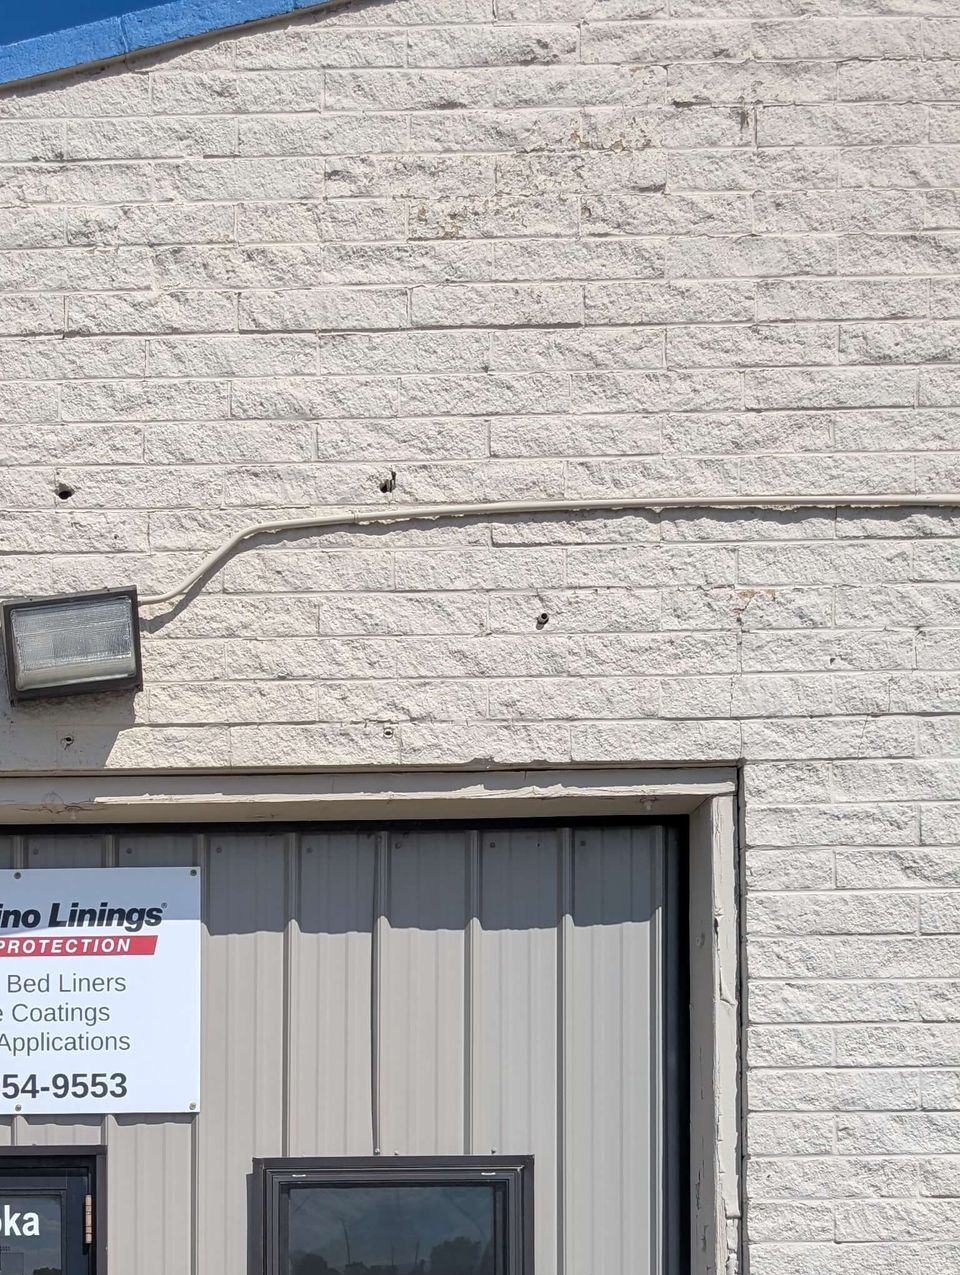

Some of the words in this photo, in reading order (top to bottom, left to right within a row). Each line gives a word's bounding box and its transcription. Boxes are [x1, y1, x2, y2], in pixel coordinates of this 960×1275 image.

[8, 974, 49, 992] Bed
[60, 973, 126, 992] Liners
[12, 1003, 109, 1026] Coatings
